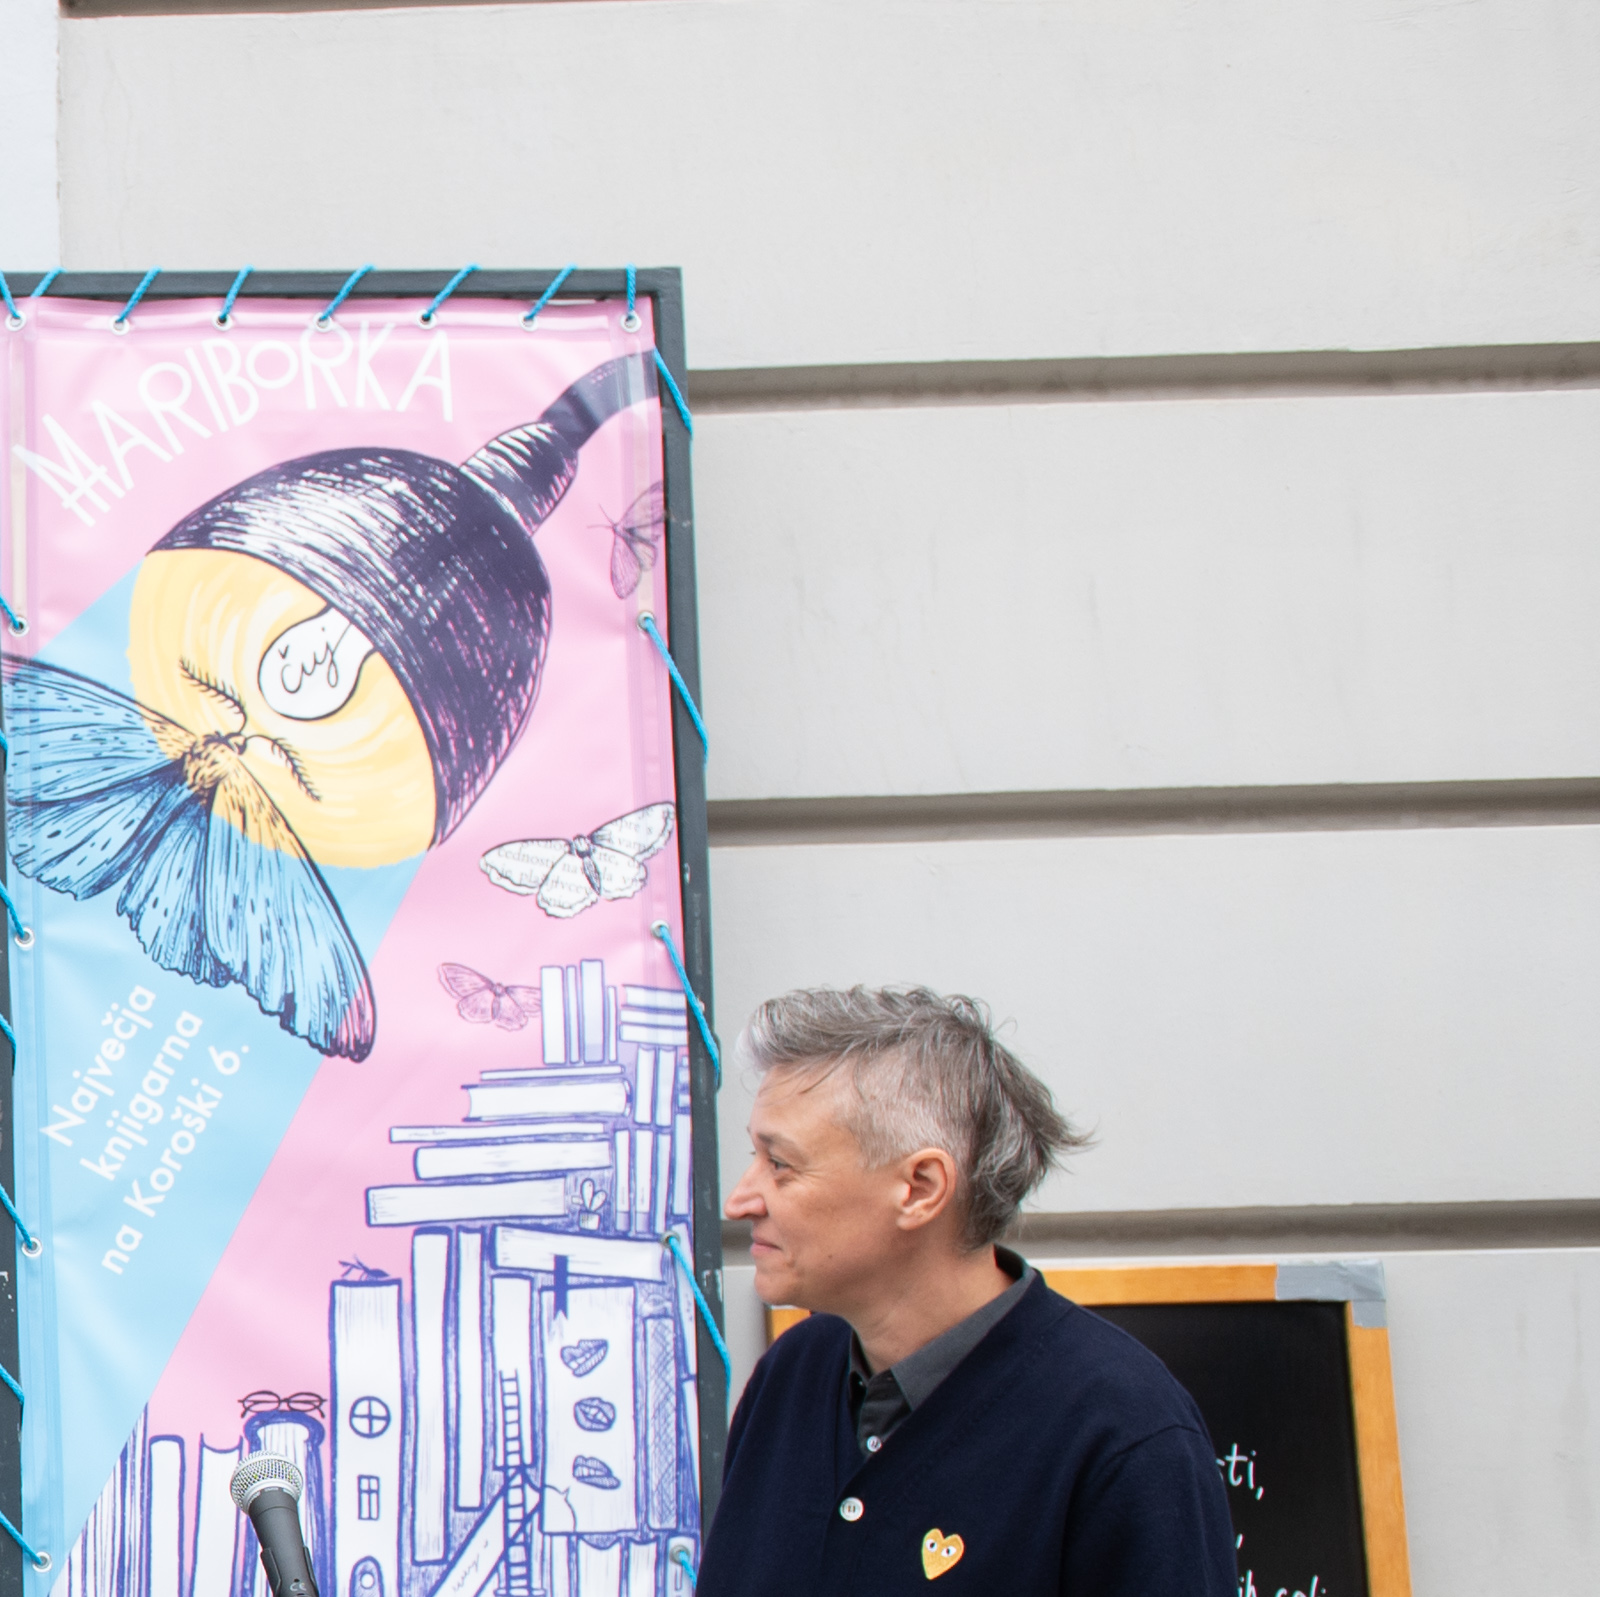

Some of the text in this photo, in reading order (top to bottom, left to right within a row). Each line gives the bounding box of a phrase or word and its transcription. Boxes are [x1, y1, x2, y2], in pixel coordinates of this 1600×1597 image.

[11, 316, 457, 528] MARIBORKA
[38, 985, 157, 1148] Največja
[78, 1010, 204, 1182] knjigarna
[101, 1044, 250, 1276] na Koroški 6.
